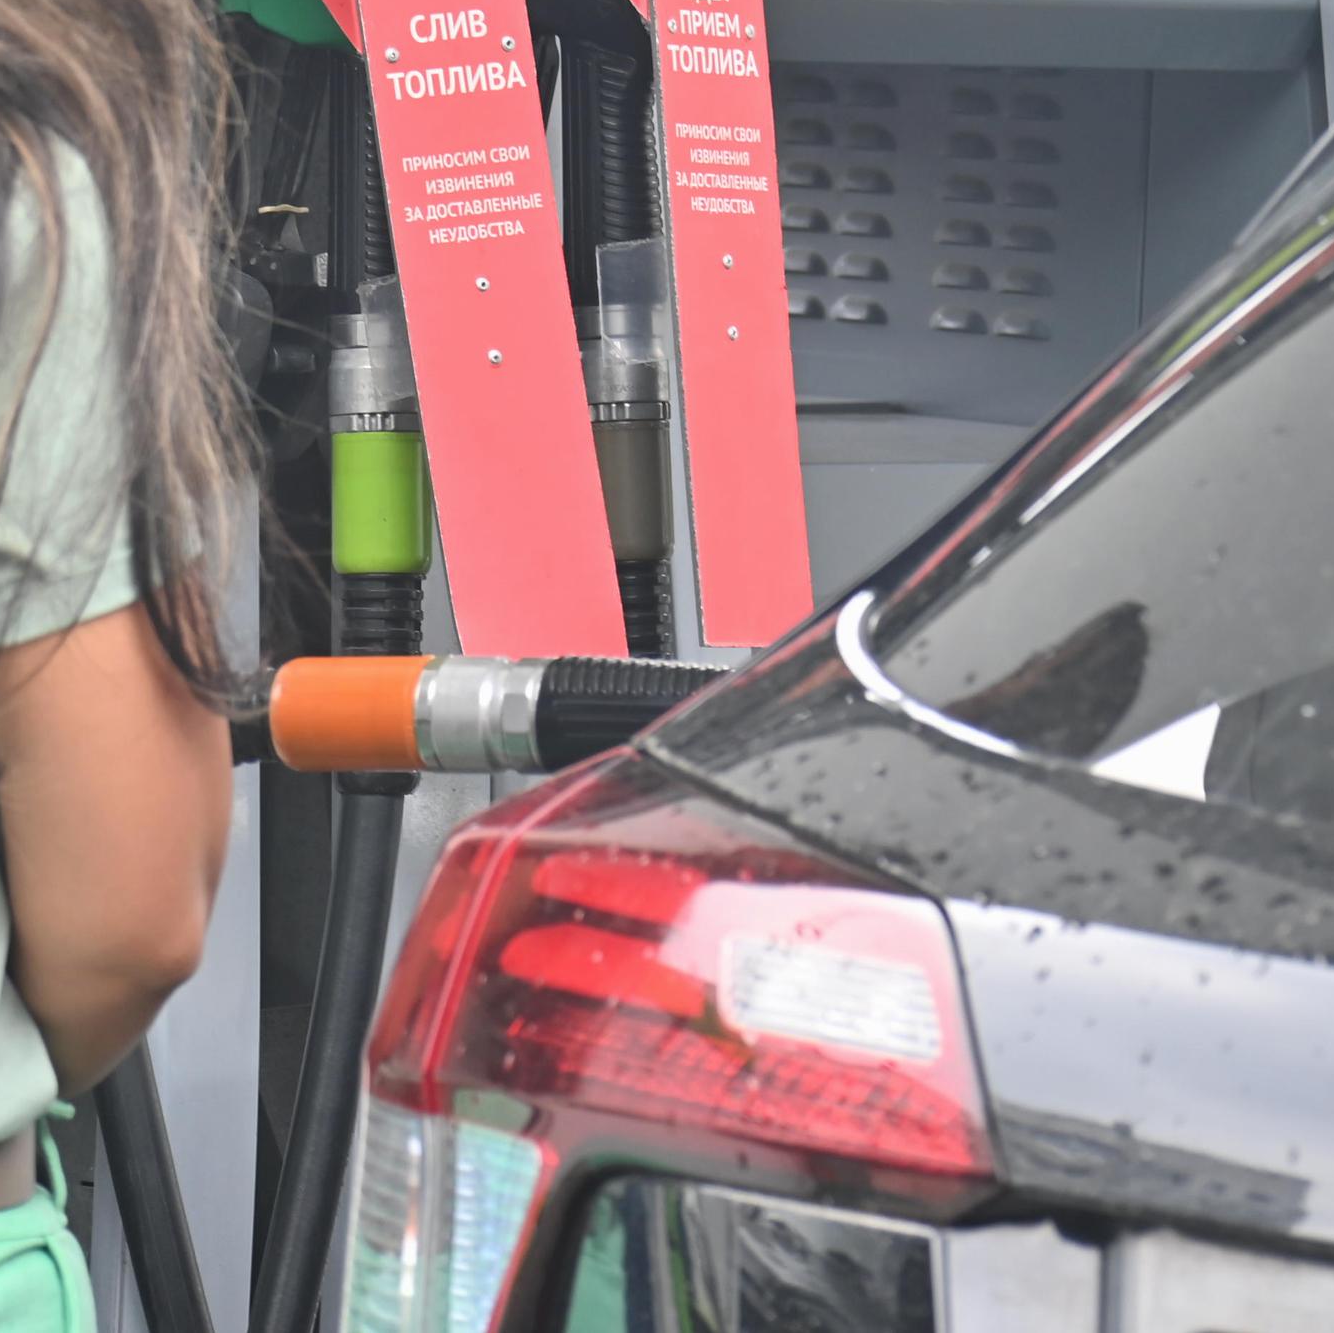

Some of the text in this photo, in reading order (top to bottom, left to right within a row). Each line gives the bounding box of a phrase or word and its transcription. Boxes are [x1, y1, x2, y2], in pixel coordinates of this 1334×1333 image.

[409, 9, 488, 44] СЛИВ
[679, 10, 740, 39] ПРИЕМ
[667, 44, 759, 78] ТОПЛИВА
[386, 60, 526, 102] ТОПЛИВА
[675, 122, 762, 143] ПРИНОСИМ СВОИ
[402, 145, 530, 173] ПРИНОСИМ СВОИ
[689, 149, 750, 167] ИЗВИНЕНИЯ
[425, 171, 515, 195] ИЗВИНЕНИЯ
[675, 171, 769, 193] ЗА ДОСТАВЛЕННЫЕ
[404, 193, 543, 223] ЗА ДОСТАВЛЕННЫЕ
[690, 196, 756, 215] НЕУДОБСТВА
[428, 220, 525, 245] НЕУДОБСТВА
